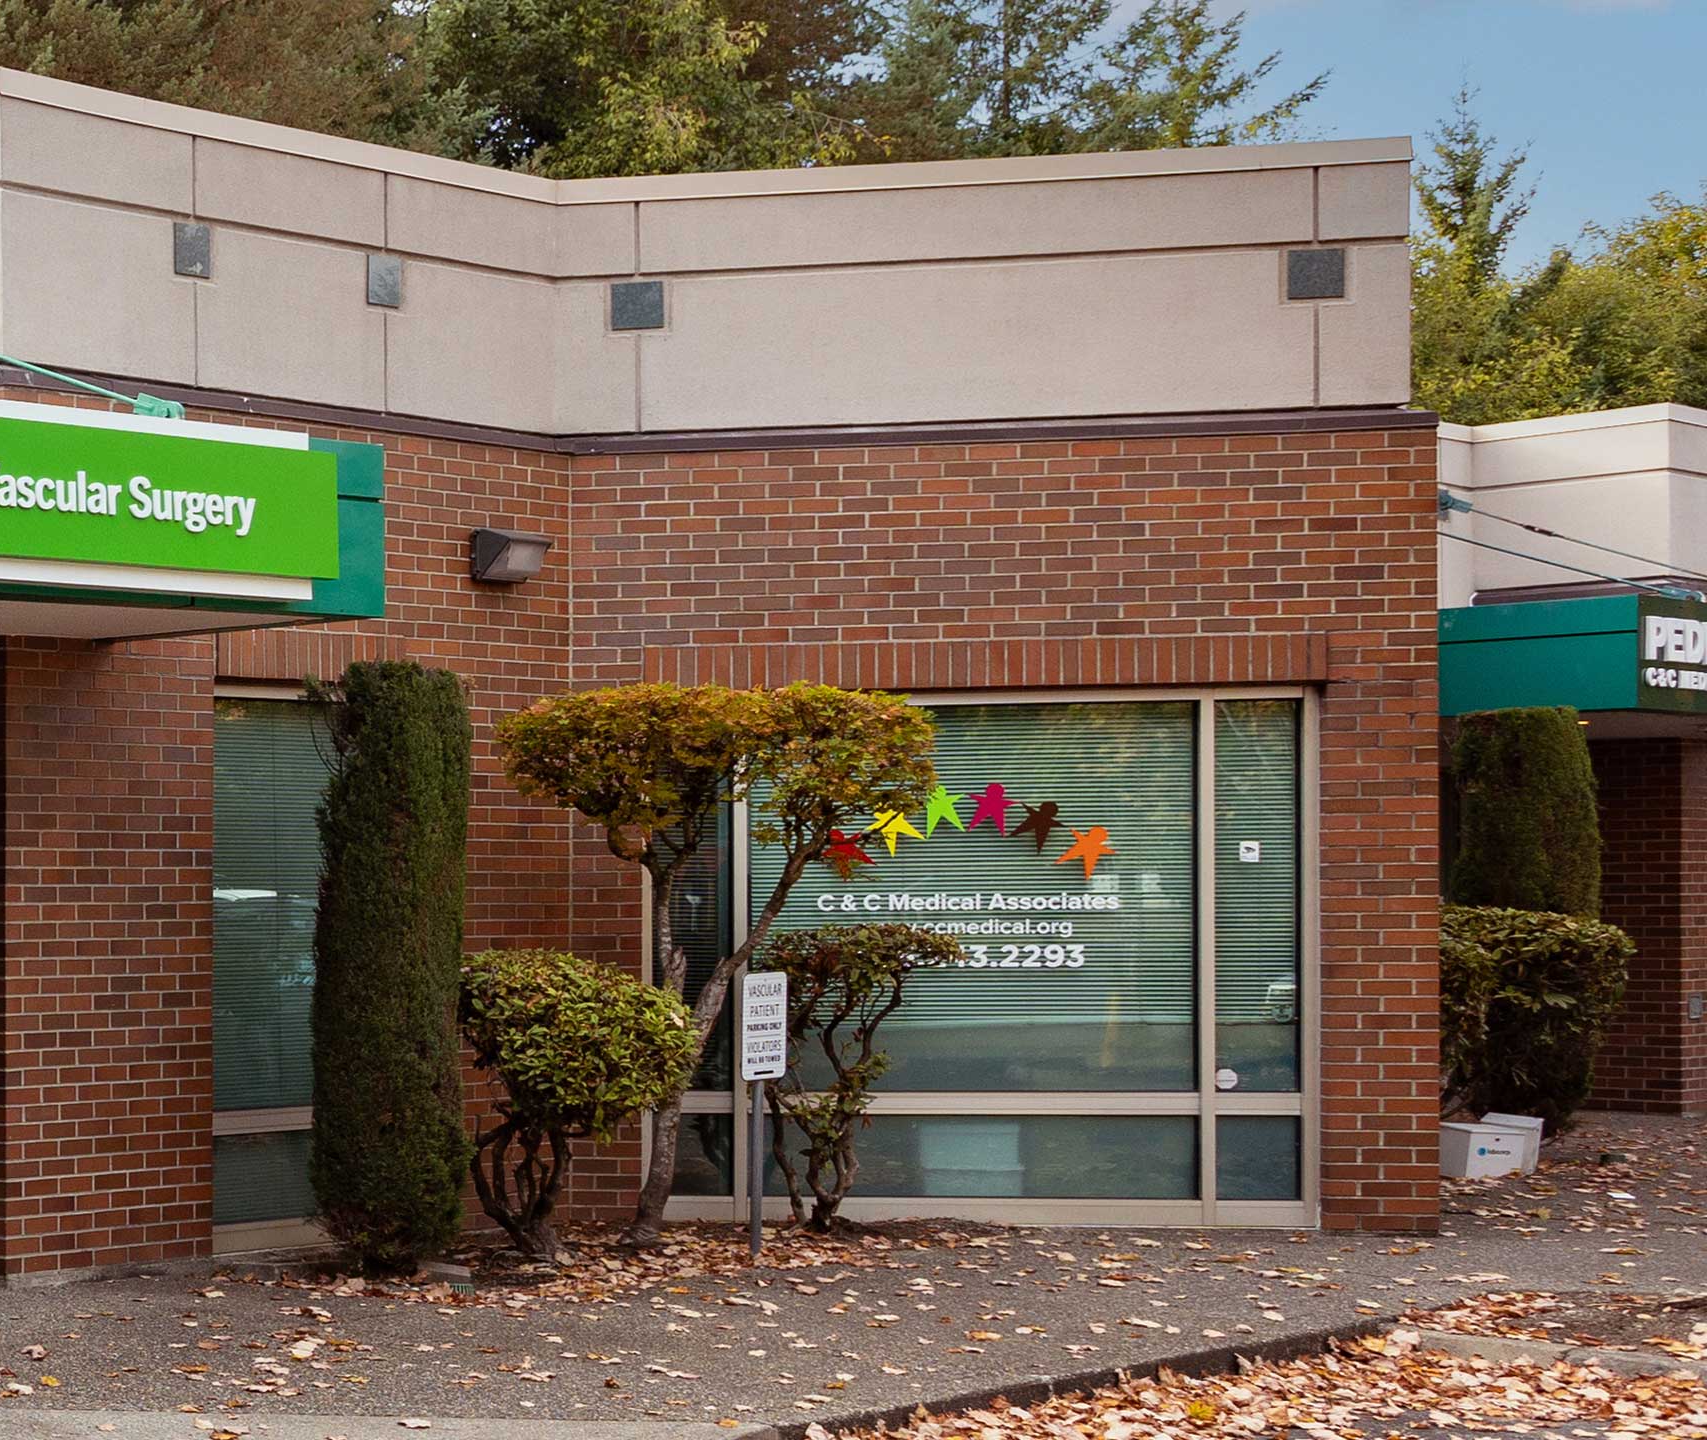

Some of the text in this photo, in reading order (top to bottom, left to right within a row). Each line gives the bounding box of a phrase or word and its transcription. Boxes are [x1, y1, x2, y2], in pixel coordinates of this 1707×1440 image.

[128, 475, 257, 537] Surgery
[1644, 667, 1677, 688] C&C
[817, 891, 1120, 912] C & C Medical Associates
[748, 983, 783, 997] VASCULAR
[750, 1004, 780, 1018] PATIENT
[747, 1022, 783, 1032] PARKING ONLY
[747, 1040, 782, 1054] VIOLATORS
[765, 1055, 781, 1063] TOWED
